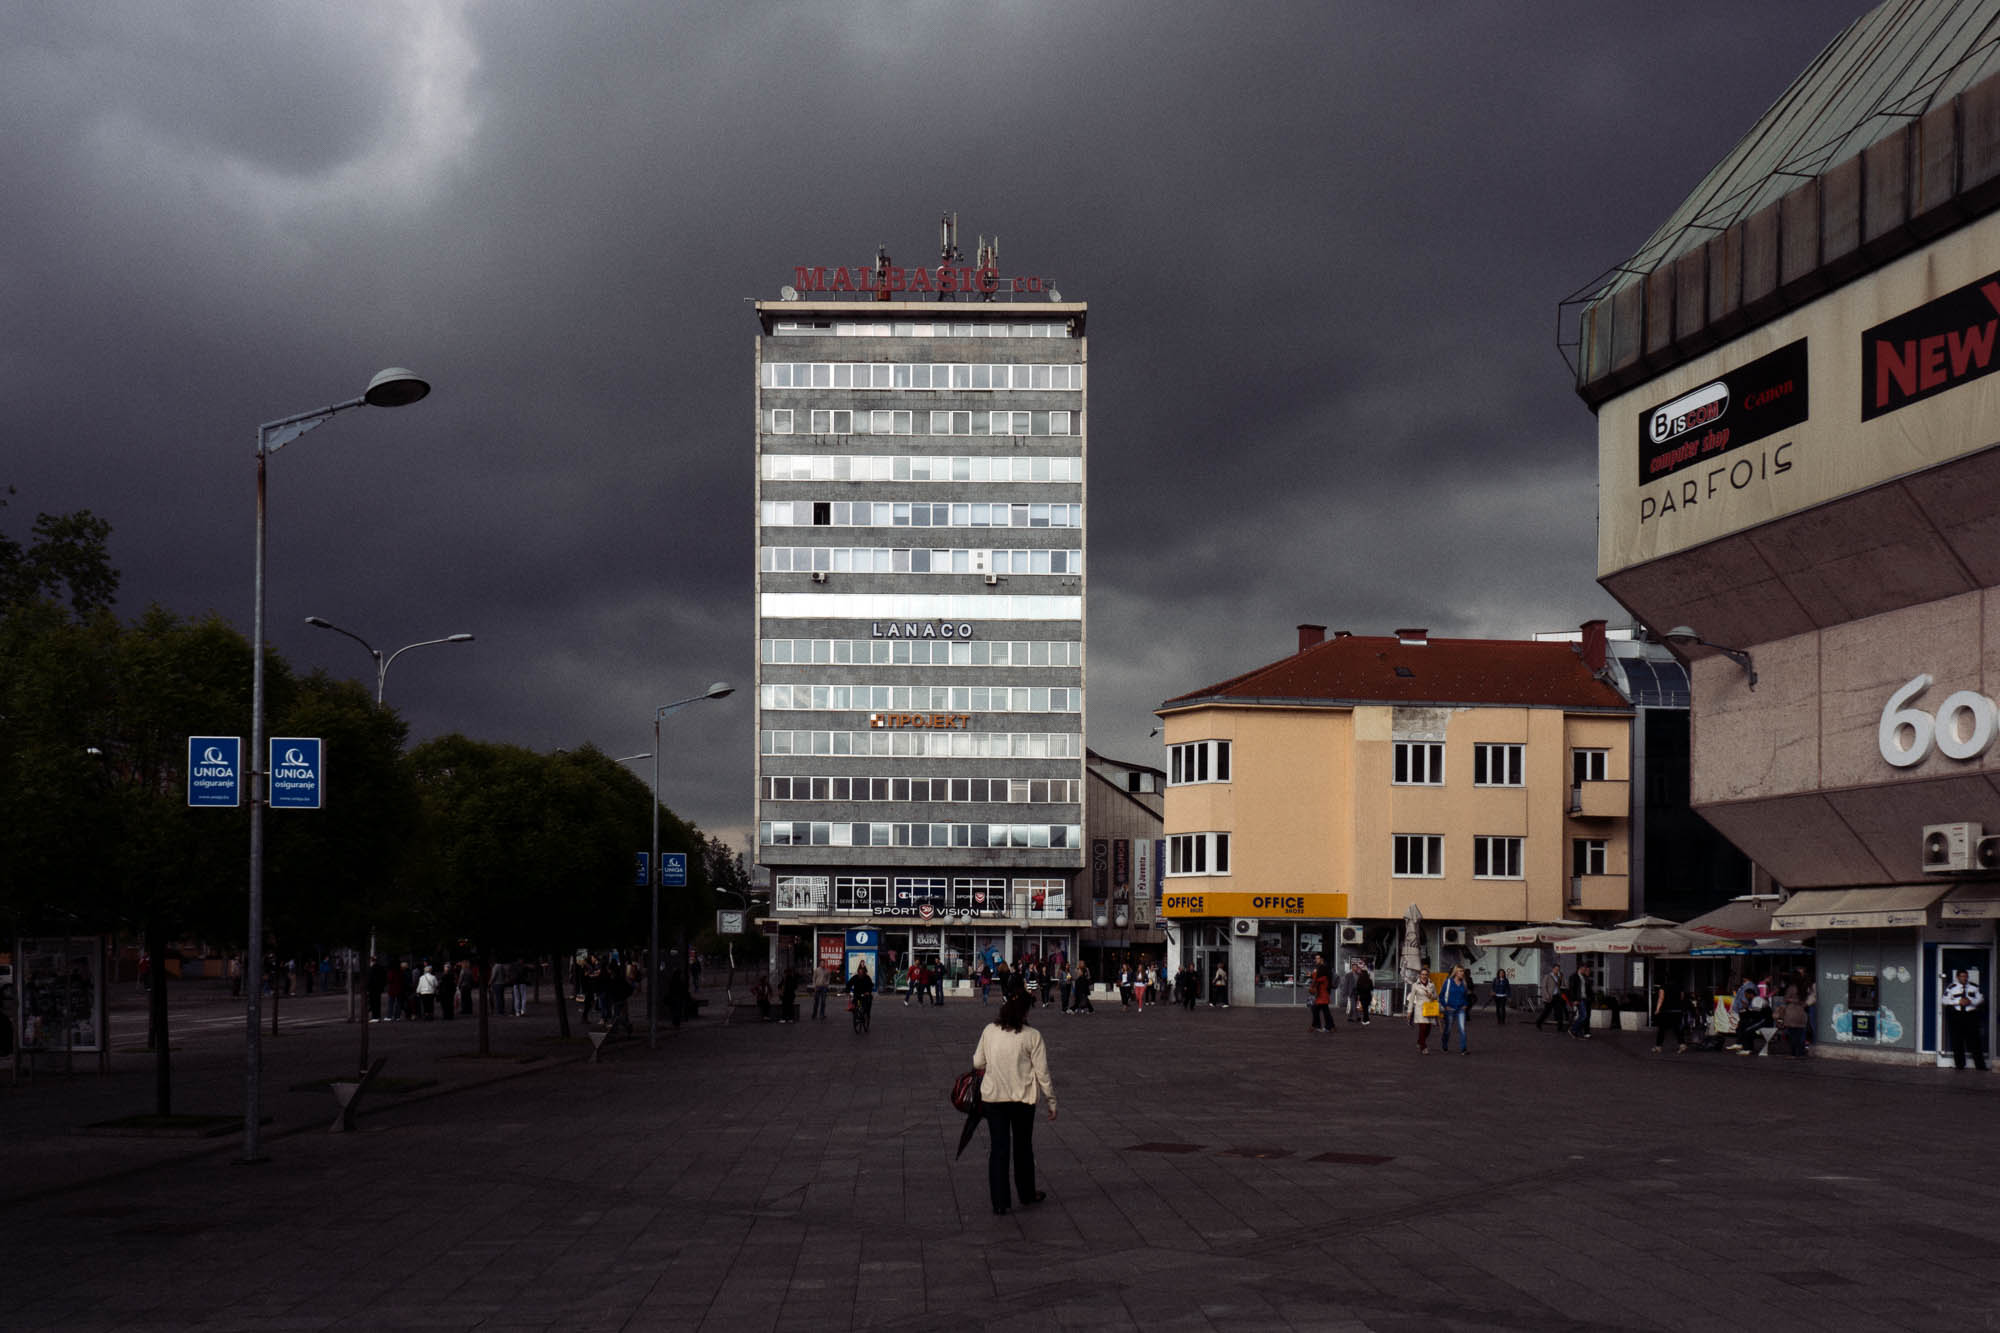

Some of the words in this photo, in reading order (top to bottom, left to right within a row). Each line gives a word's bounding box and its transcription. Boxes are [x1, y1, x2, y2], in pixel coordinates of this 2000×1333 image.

[1875, 319, 1999, 409] NEW
[1743, 379, 1794, 412] Canon
[1649, 437, 1700, 474] computer
[1702, 425, 1732, 454] shop
[1641, 442, 1793, 524] PARFOIS
[872, 622, 973, 638] LANACO
[193, 767, 234, 778] UNIQA
[274, 768, 315, 779] UNIQA
[193, 779, 235, 789] osiguranje
[274, 780, 316, 791] osiguranje
[1167, 896, 1204, 908] OFFICE
[1252, 896, 1305, 909] OFFICE
[873, 906, 918, 916] SPORT
[935, 908, 981, 917] VISION
